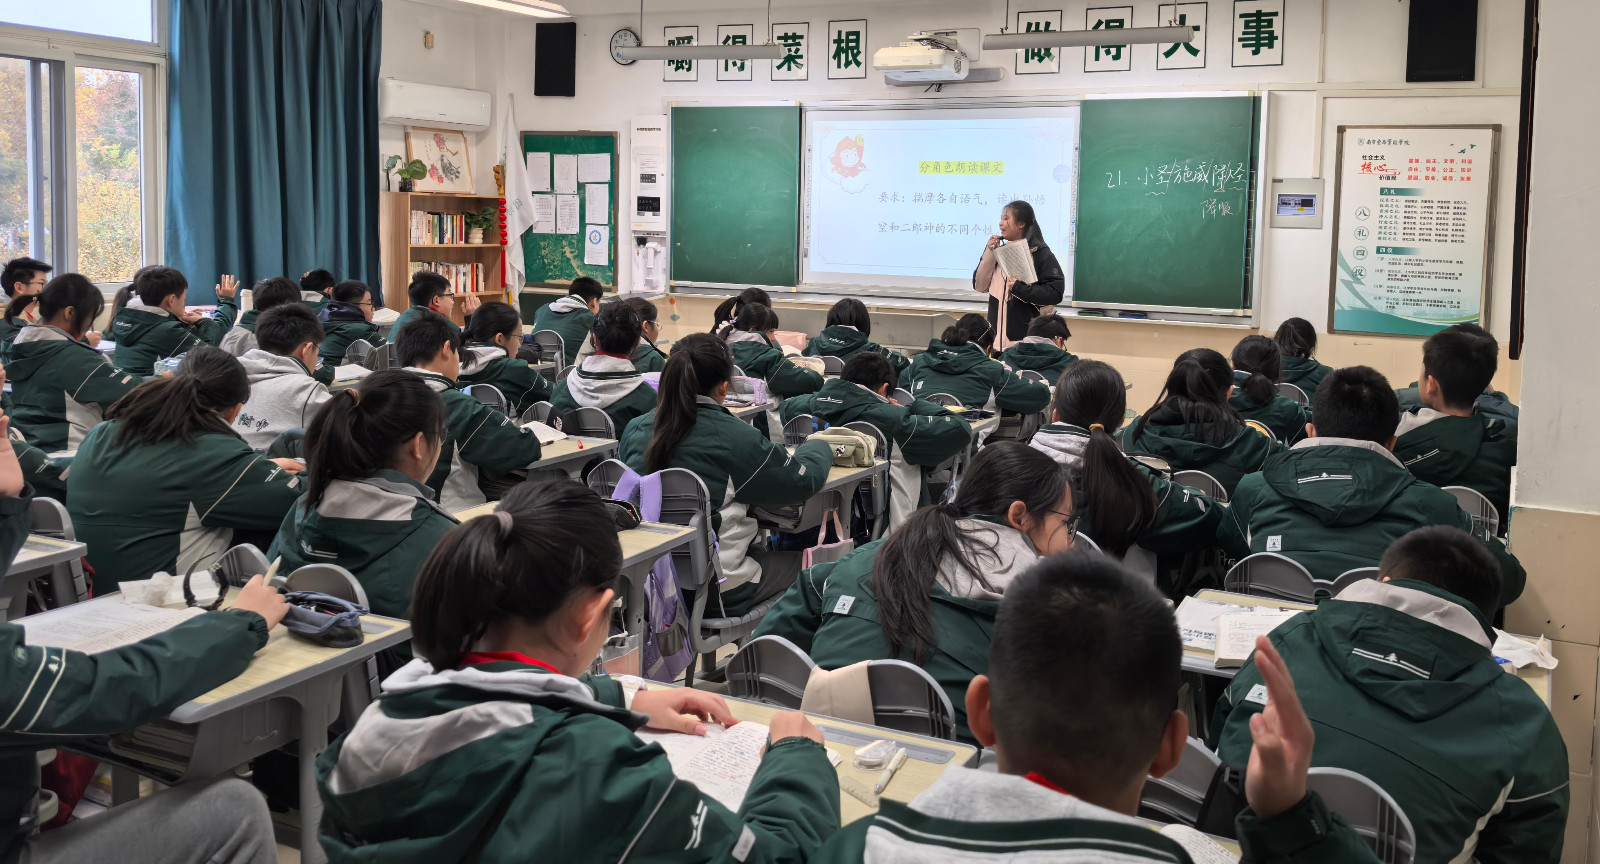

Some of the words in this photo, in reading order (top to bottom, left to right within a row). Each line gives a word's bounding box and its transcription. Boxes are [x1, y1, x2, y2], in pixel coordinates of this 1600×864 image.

[919, 161, 1003, 173] 分角色朗读课文
[1361, 161, 1388, 174] 核心
